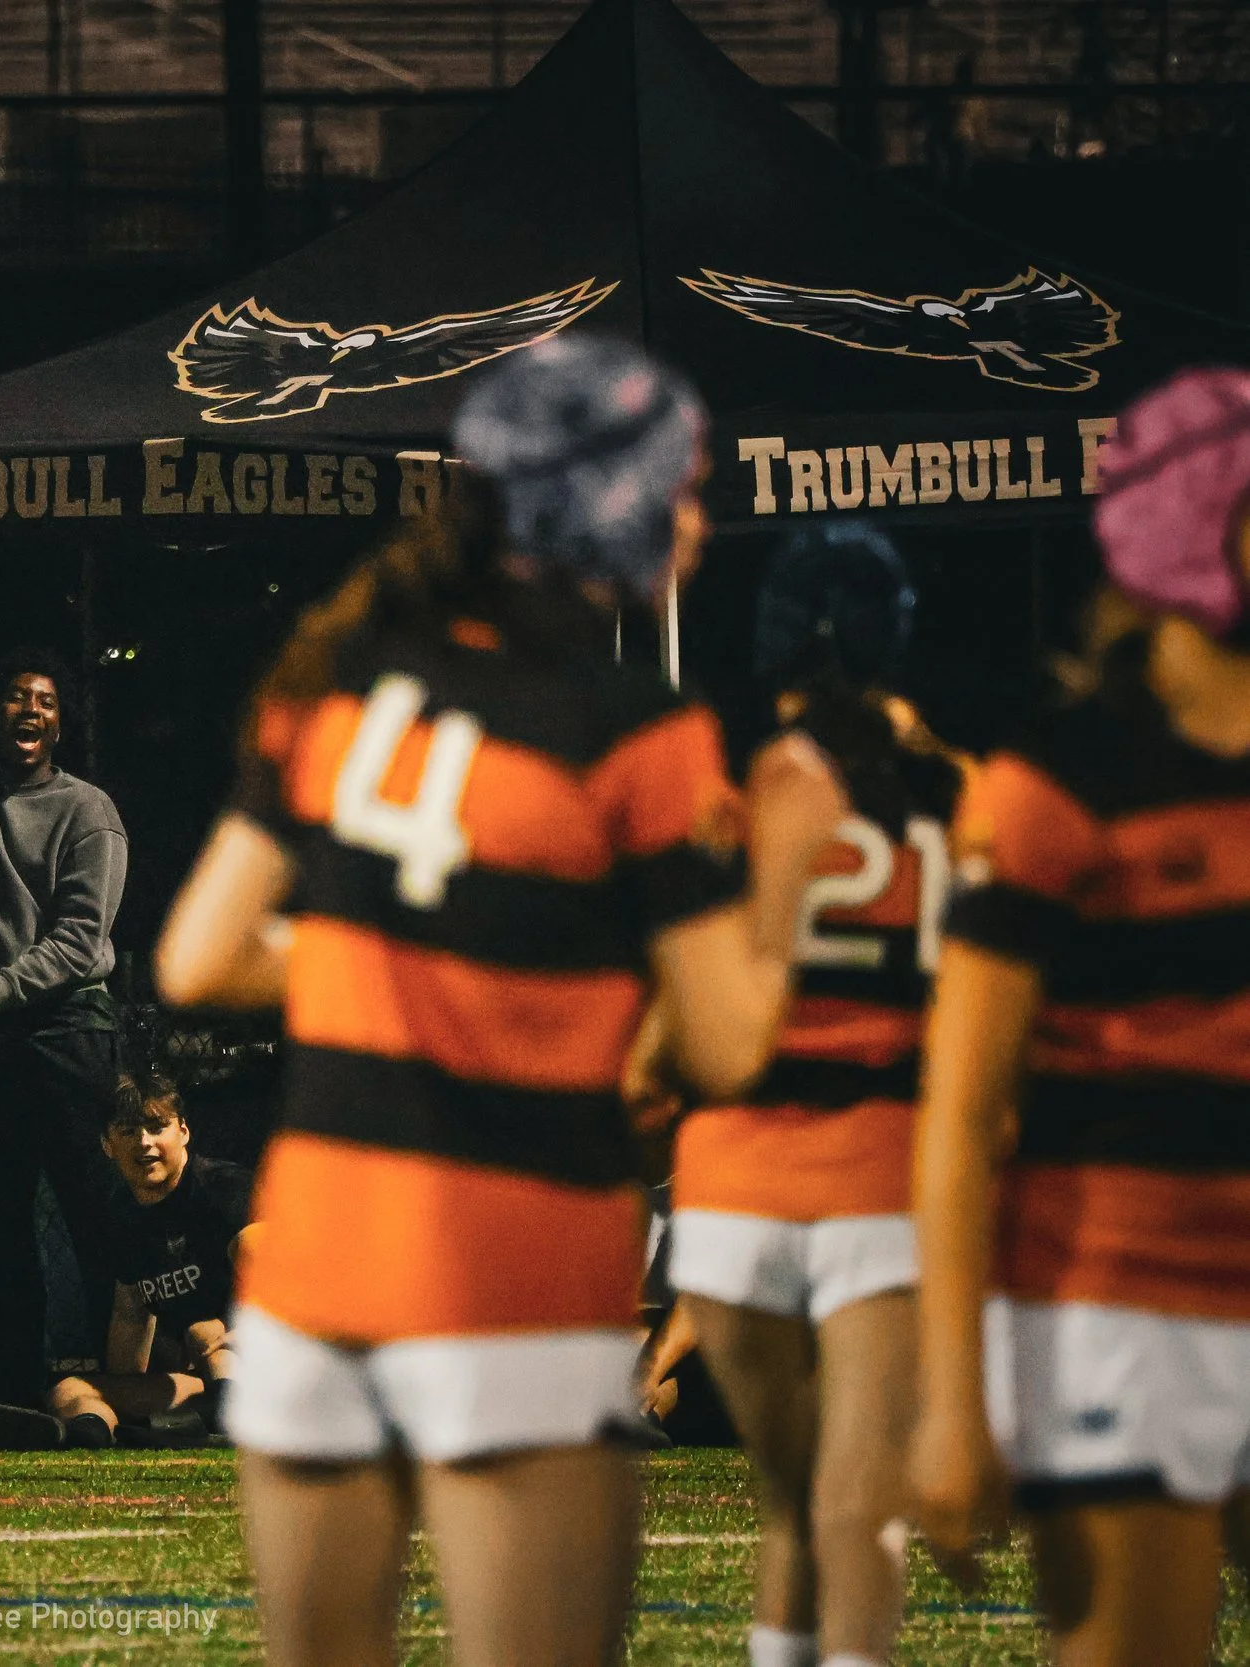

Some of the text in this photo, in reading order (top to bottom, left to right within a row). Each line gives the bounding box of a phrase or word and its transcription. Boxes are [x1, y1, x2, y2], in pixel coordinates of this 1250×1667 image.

[143, 438, 378, 515] EAGLES
[738, 436, 1062, 515] TRUMBULL
[331, 673, 483, 909] 4
[792, 814, 949, 972] 21
